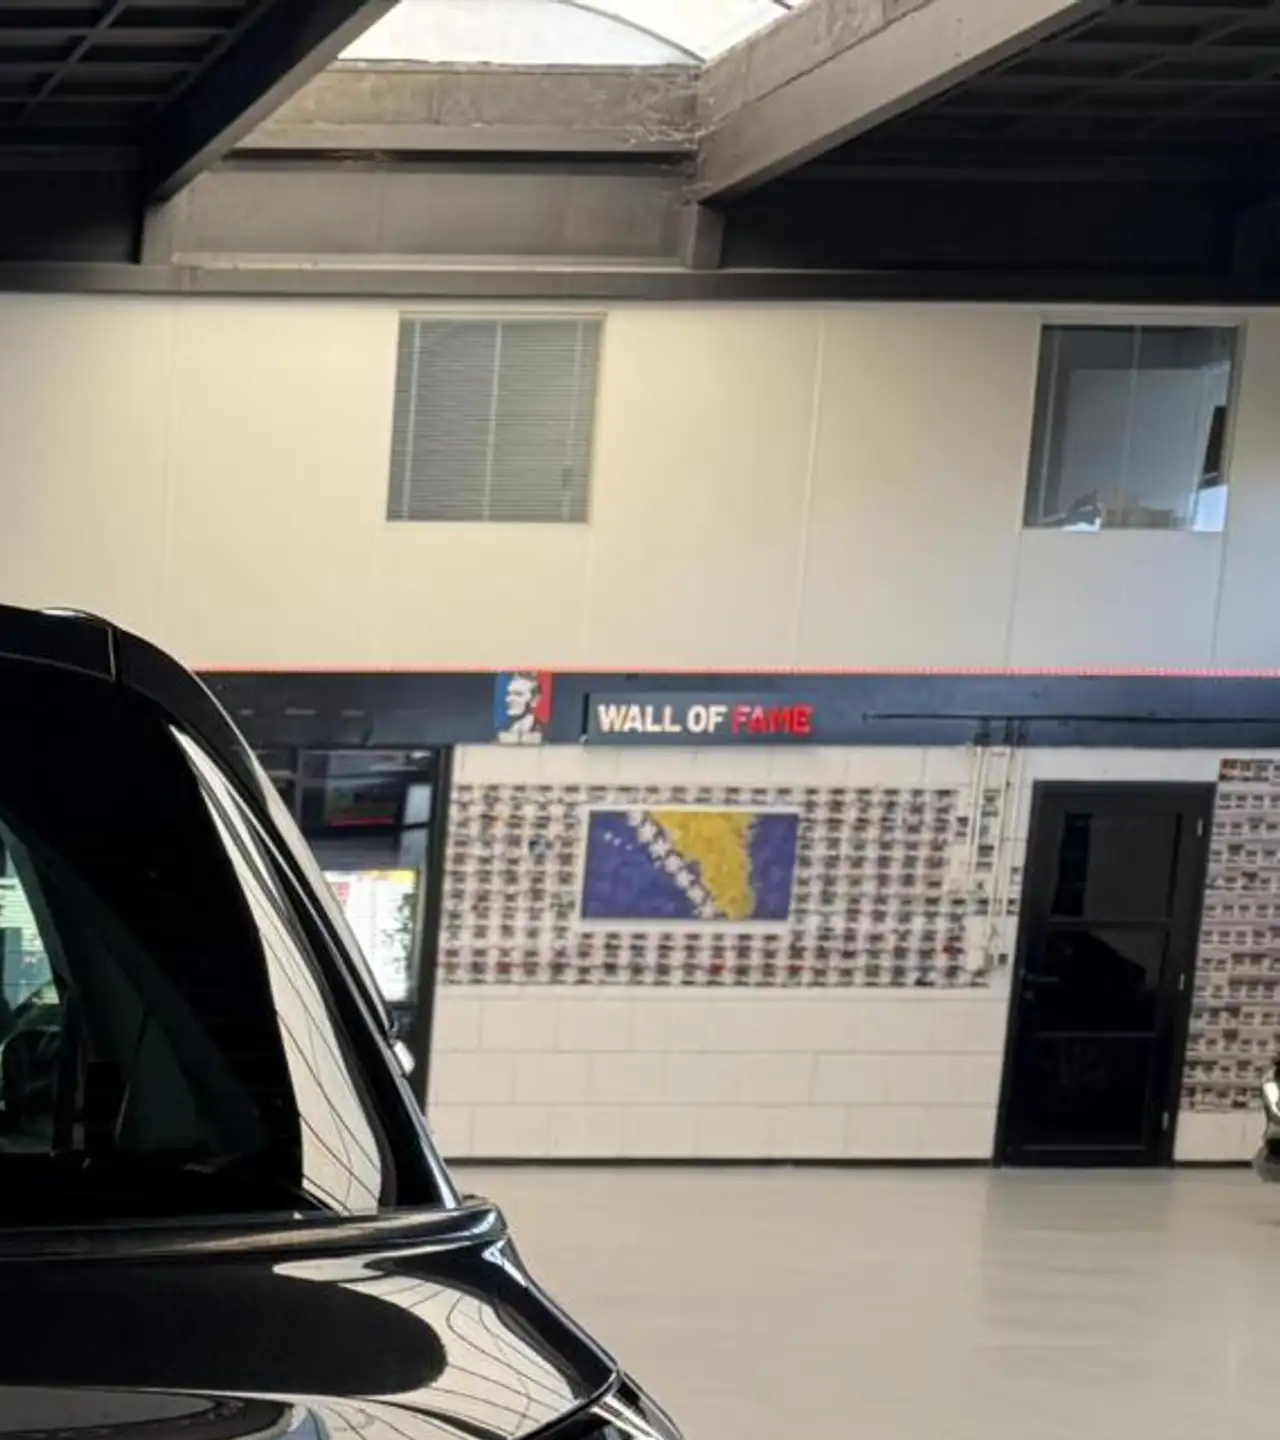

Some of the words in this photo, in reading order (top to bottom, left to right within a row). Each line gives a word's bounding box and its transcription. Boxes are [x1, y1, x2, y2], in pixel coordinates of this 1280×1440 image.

[597, 704, 682, 733] WALL
[687, 704, 728, 733] OF
[730, 704, 814, 736] FAME
